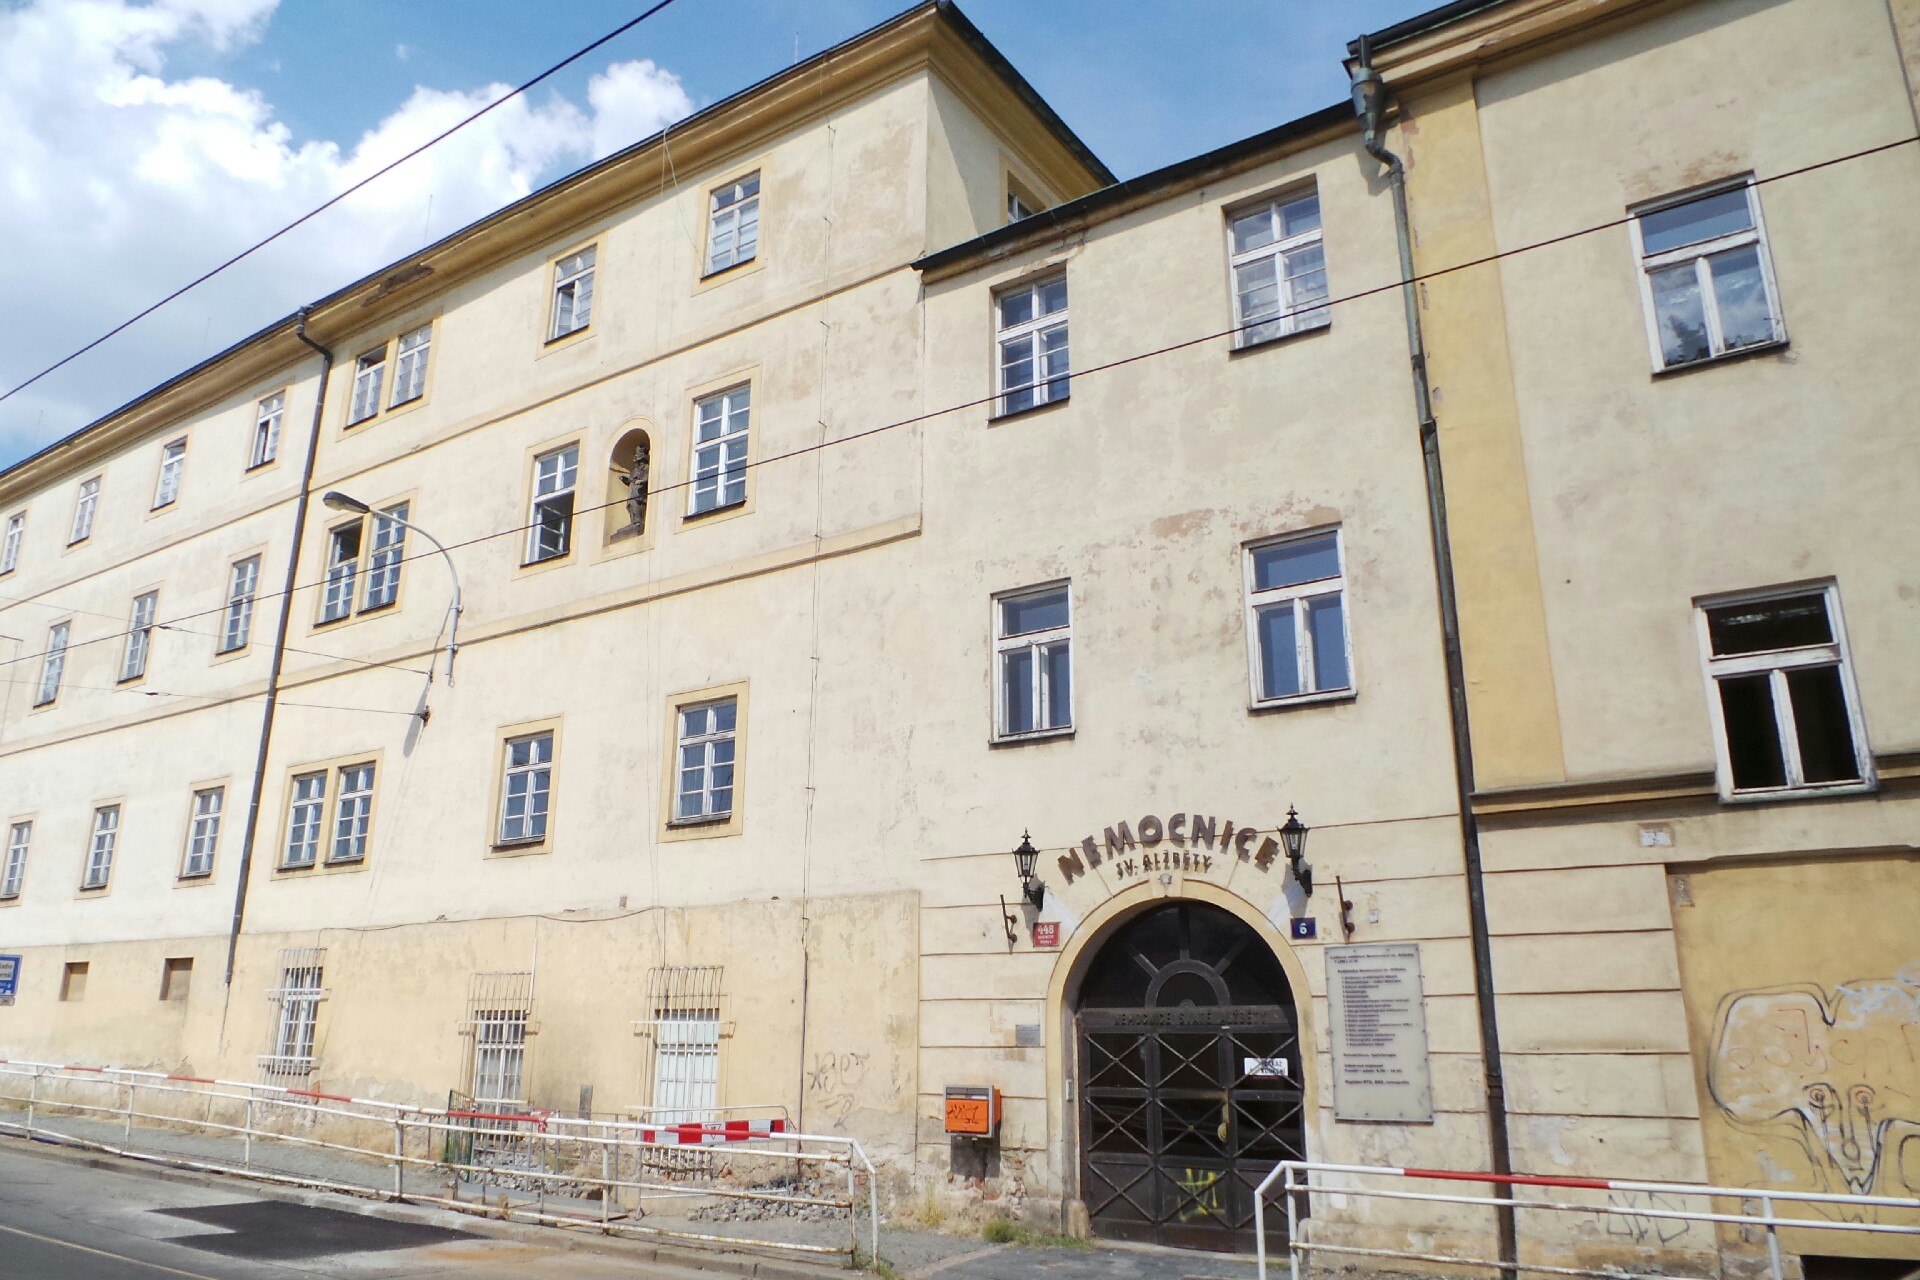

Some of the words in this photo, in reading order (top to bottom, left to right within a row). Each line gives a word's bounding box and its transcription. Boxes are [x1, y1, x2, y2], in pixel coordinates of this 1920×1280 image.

[1058, 813, 1280, 884] NEMOCNICE
[1116, 858, 1138, 879] SV.
[1037, 924, 1054, 935] 448
[1299, 922, 1308, 935] 6
